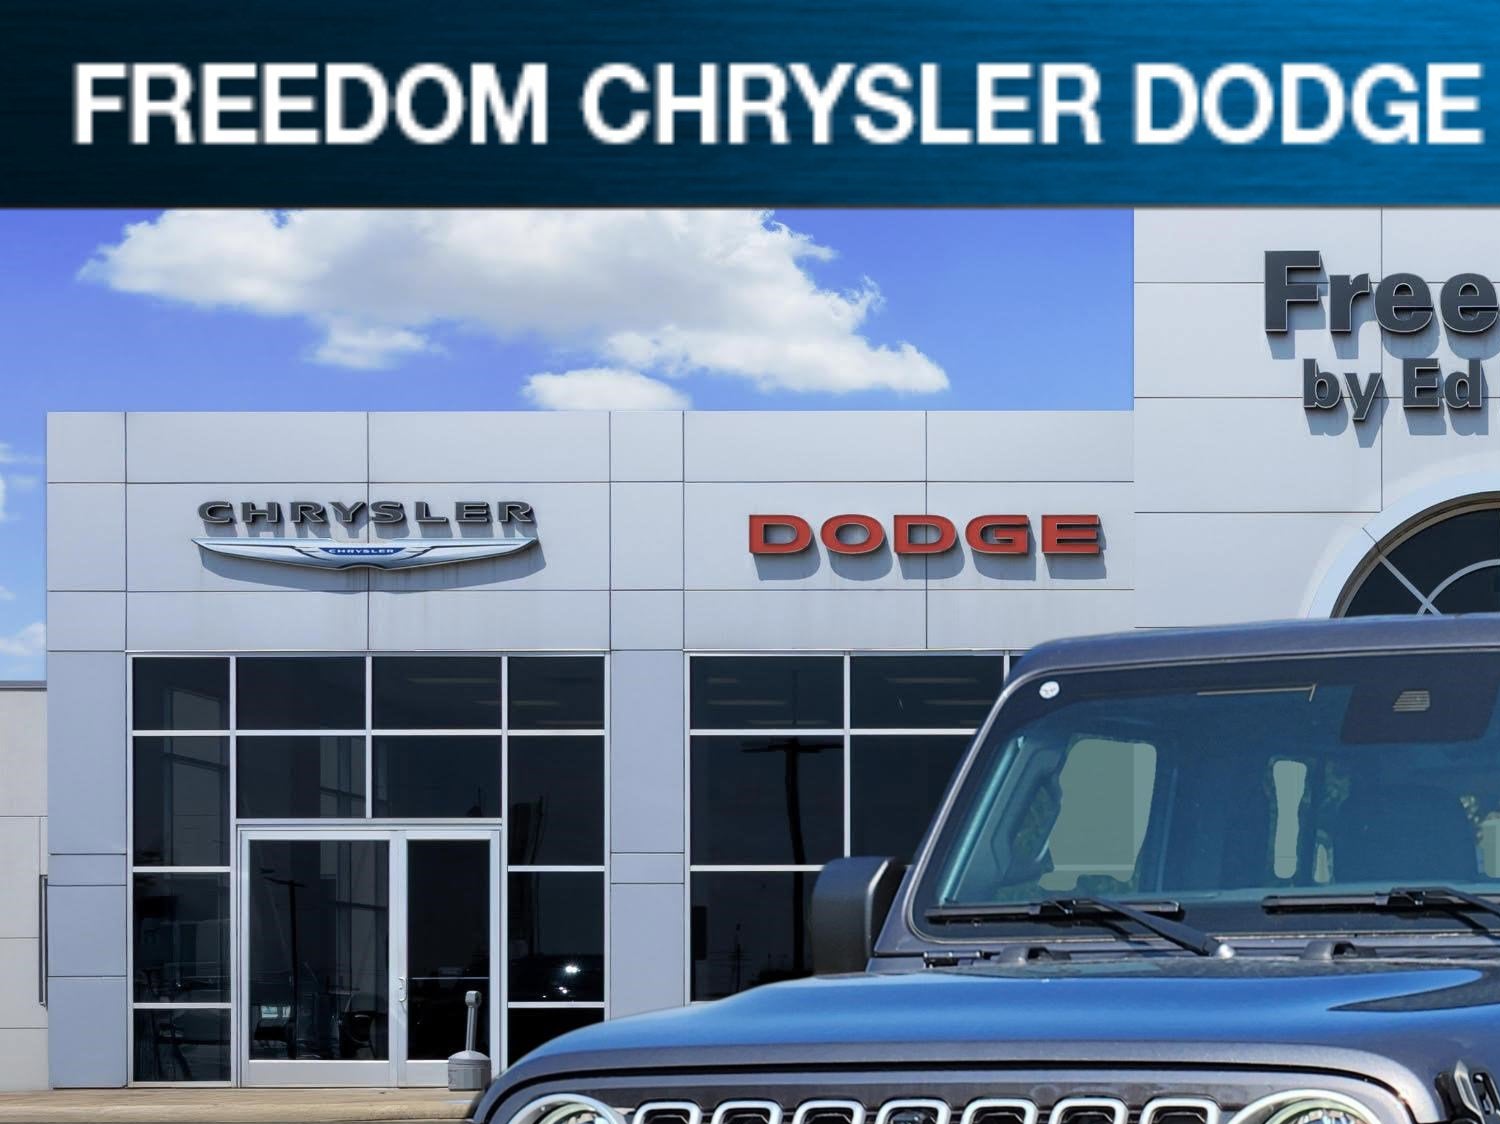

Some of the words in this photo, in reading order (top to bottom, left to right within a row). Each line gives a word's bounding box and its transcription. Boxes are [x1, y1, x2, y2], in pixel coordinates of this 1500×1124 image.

[1303, 357, 1382, 421] by
[1402, 357, 1482, 409] Ed
[199, 500, 534, 524] CHRYSLER
[748, 513, 1100, 554] DODGE
